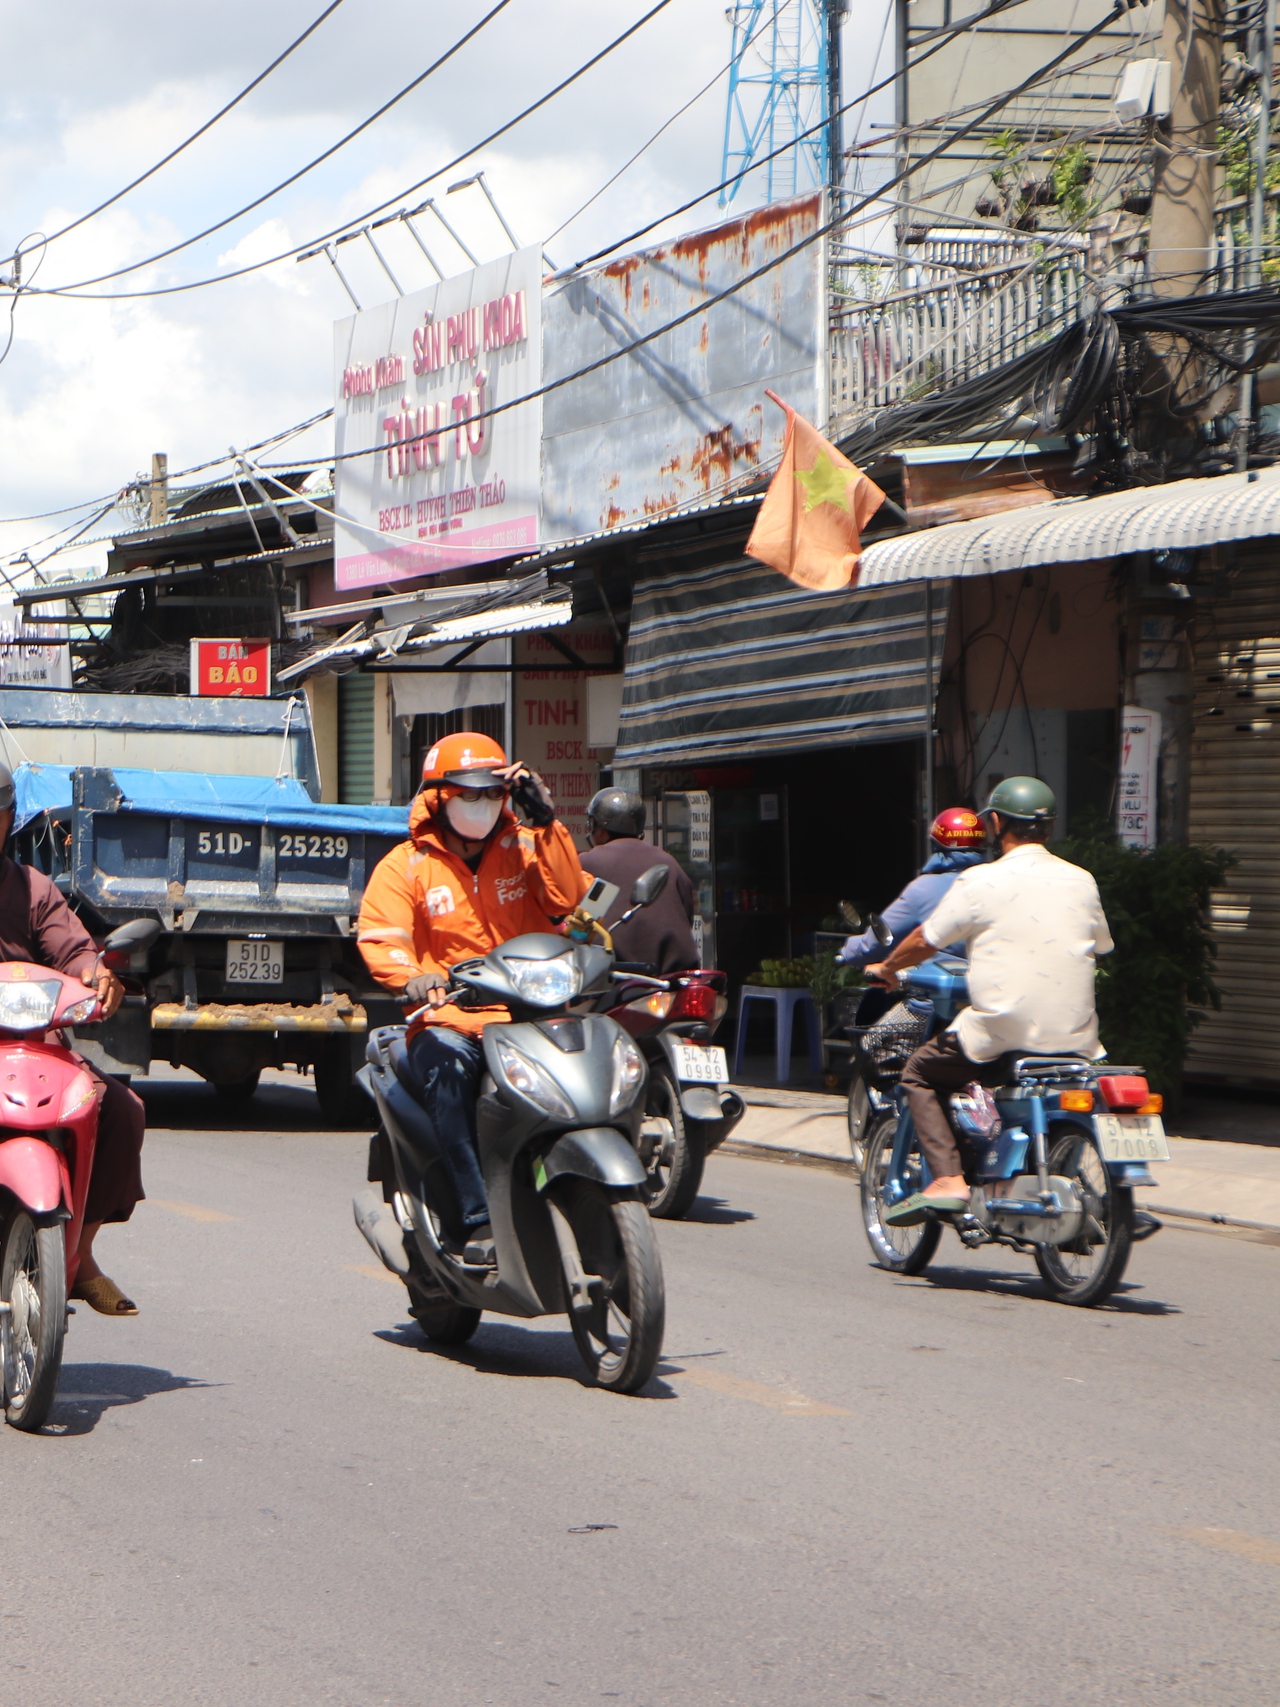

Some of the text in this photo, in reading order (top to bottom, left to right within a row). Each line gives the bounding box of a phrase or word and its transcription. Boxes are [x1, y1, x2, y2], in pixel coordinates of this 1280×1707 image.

[413, 290, 528, 375] SẢN PHỤ KHOA
[343, 360, 376, 399] Phòng
[416, 490, 447, 524] HUỲNH
[449, 483, 477, 516] THIÊN
[479, 472, 506, 509] THẢO
[218, 643, 249, 660] BÁN
[208, 661, 259, 685] BẢO
[524, 699, 579, 726] TINH
[546, 740, 584, 760] BSCK
[560, 766, 592, 797] THIÊN
[279, 834, 349, 858] 25239
[241, 943, 270, 961] 51D
[229, 961, 281, 980] 252.39
[685, 1063, 722, 1080] 0999
[1110, 1138, 1159, 1157] 7008
